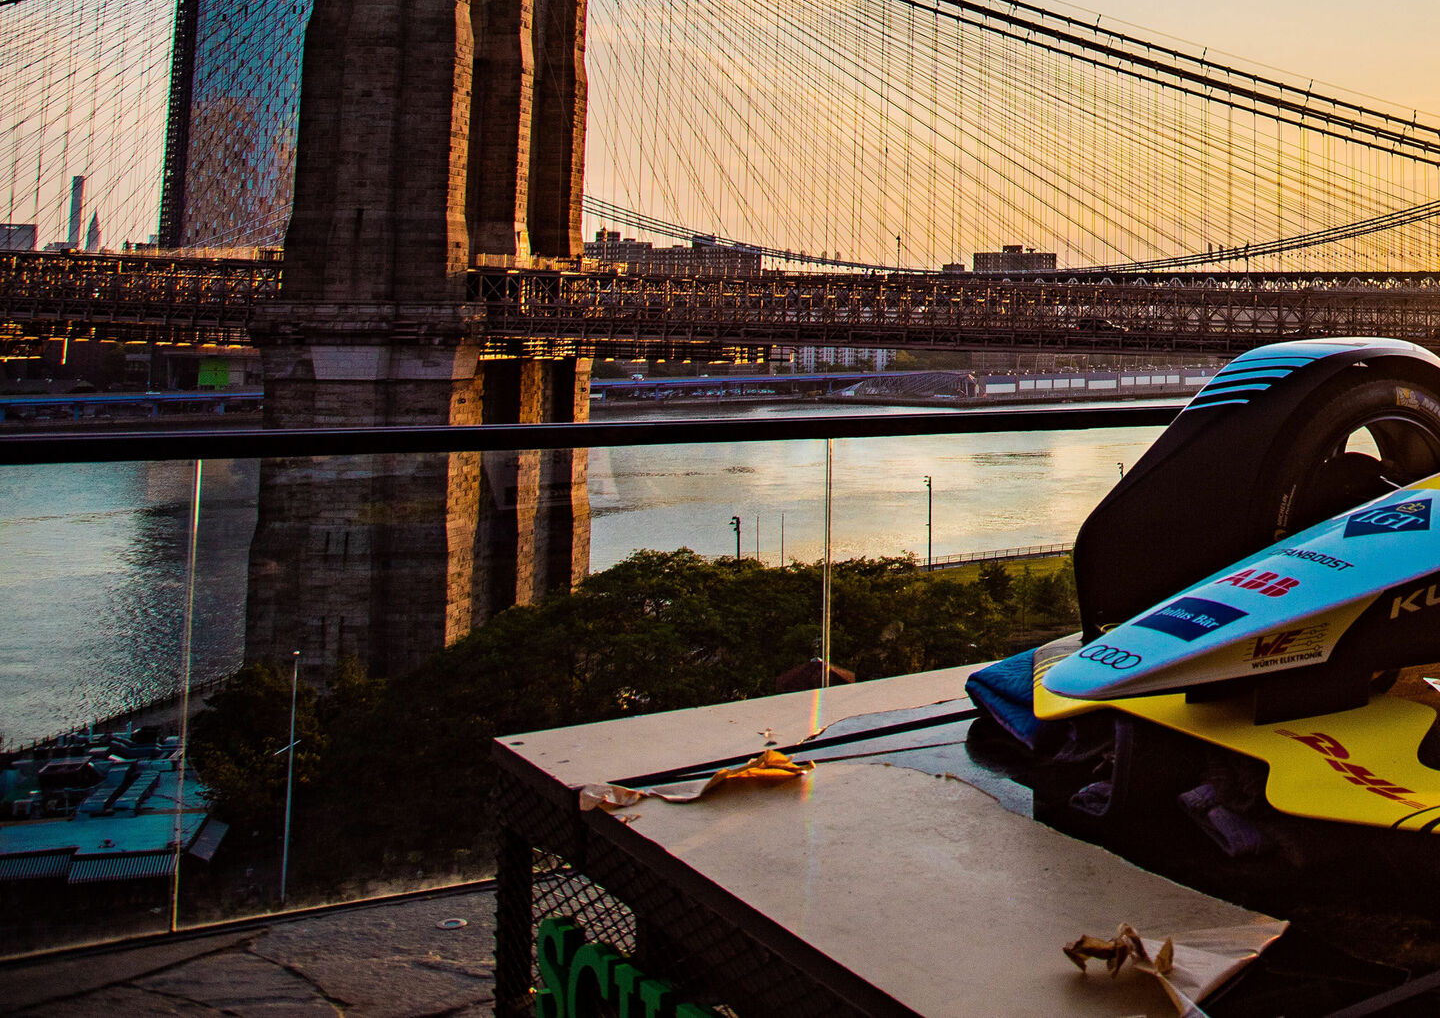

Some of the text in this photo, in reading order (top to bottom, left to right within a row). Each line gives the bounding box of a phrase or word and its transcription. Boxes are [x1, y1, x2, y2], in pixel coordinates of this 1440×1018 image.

[1353, 509, 1425, 531] LGT
[1215, 569, 1301, 598] ABB
[1157, 605, 1221, 629] Julius Bär
[1253, 629, 1304, 659] WE
[1251, 650, 1324, 669] WÜRTH ELEKTRONIK
[1290, 732, 1417, 801] DHL
